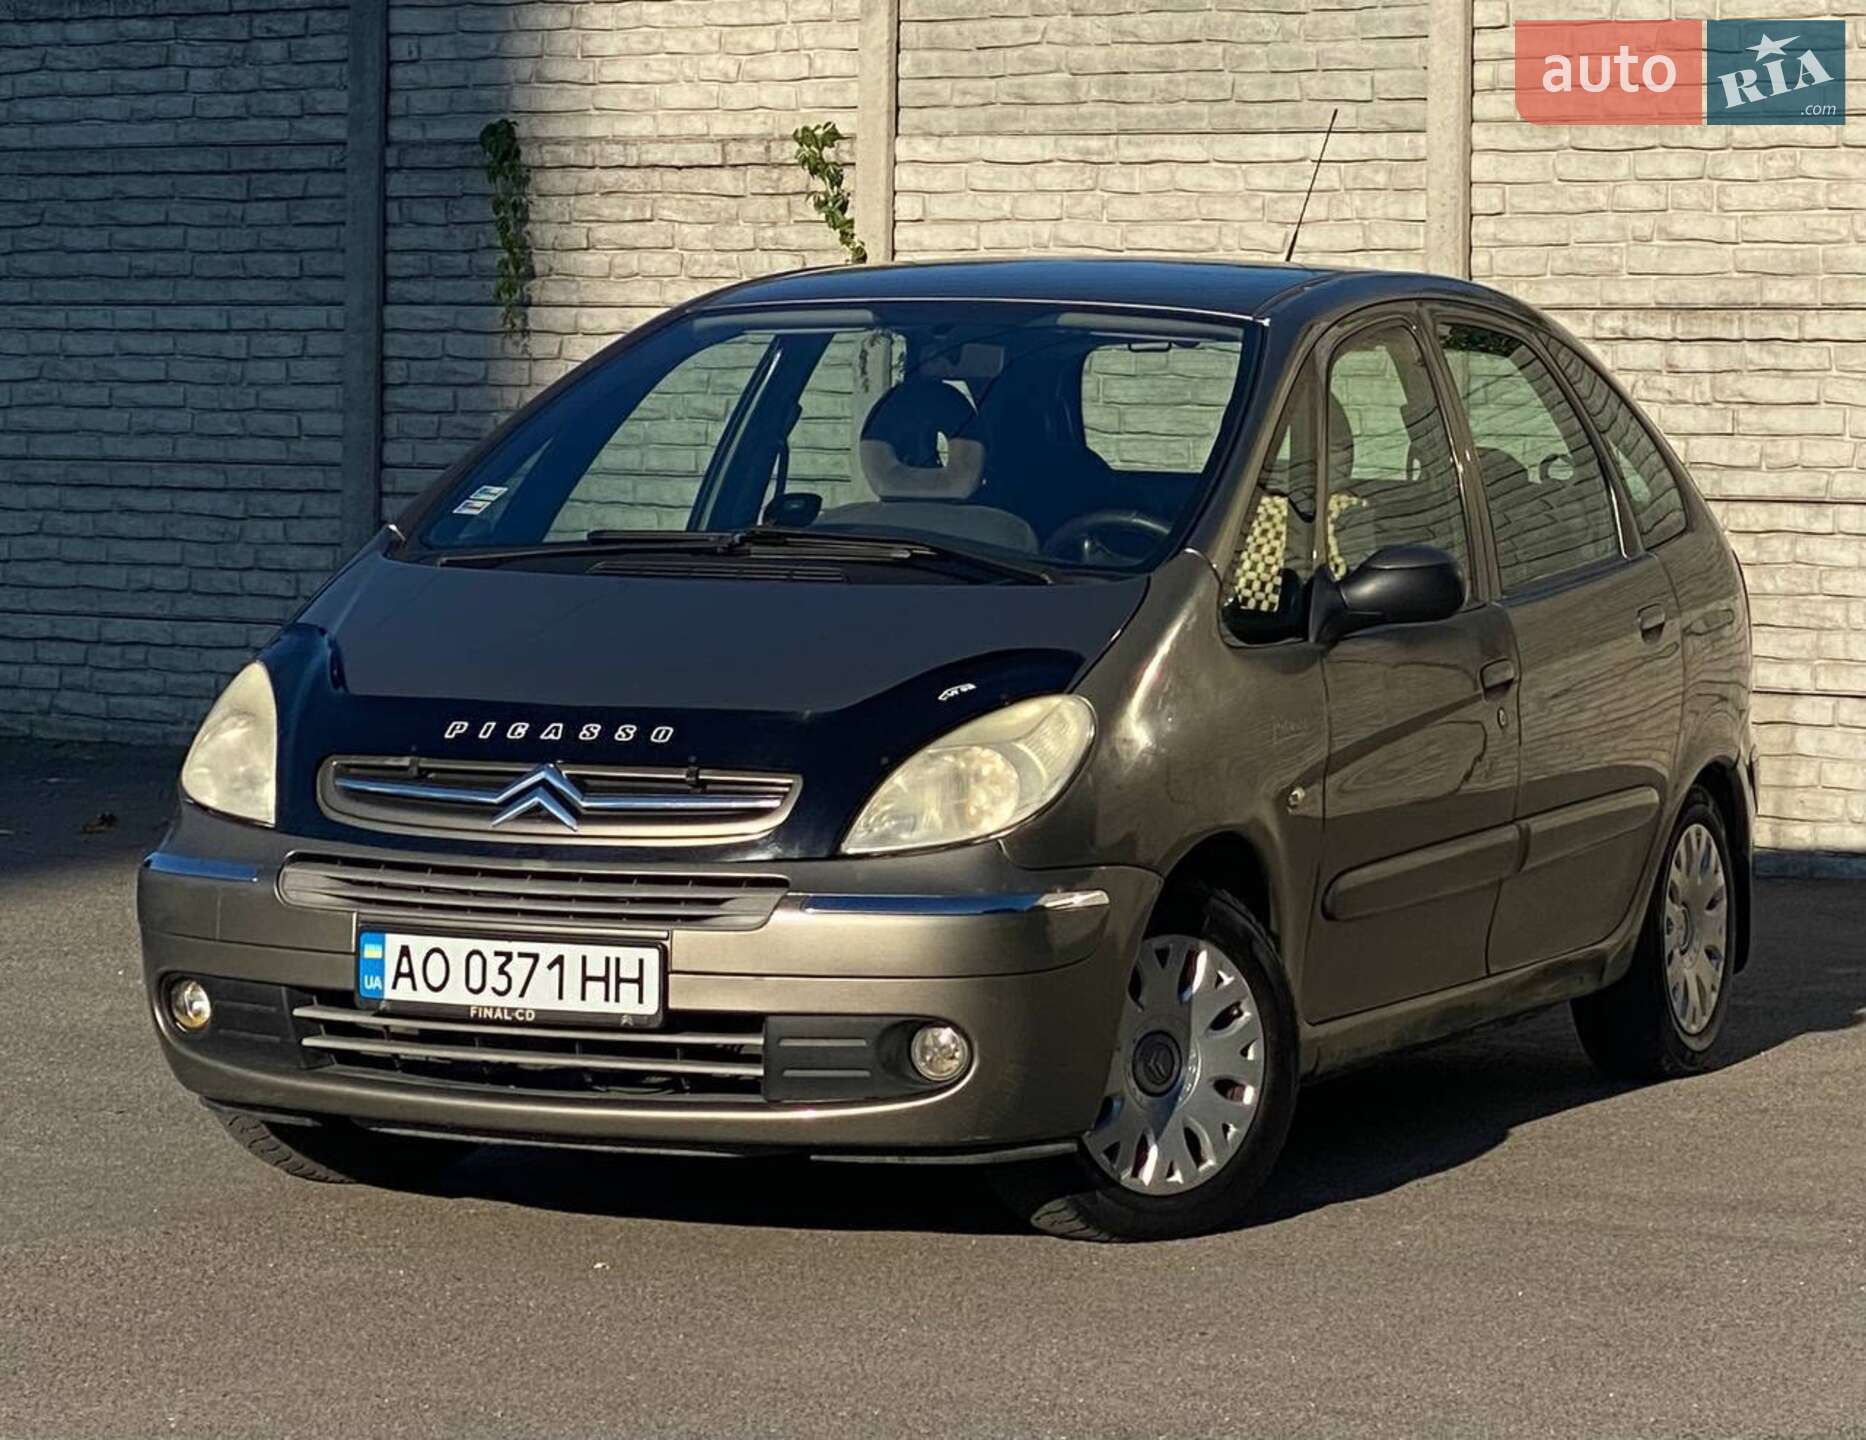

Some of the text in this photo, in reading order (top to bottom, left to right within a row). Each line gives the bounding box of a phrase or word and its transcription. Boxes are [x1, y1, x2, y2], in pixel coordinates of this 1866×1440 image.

[444, 721, 674, 743] PICASSO
[364, 975, 382, 990] UA
[391, 944, 646, 1005] AO 0371 HH
